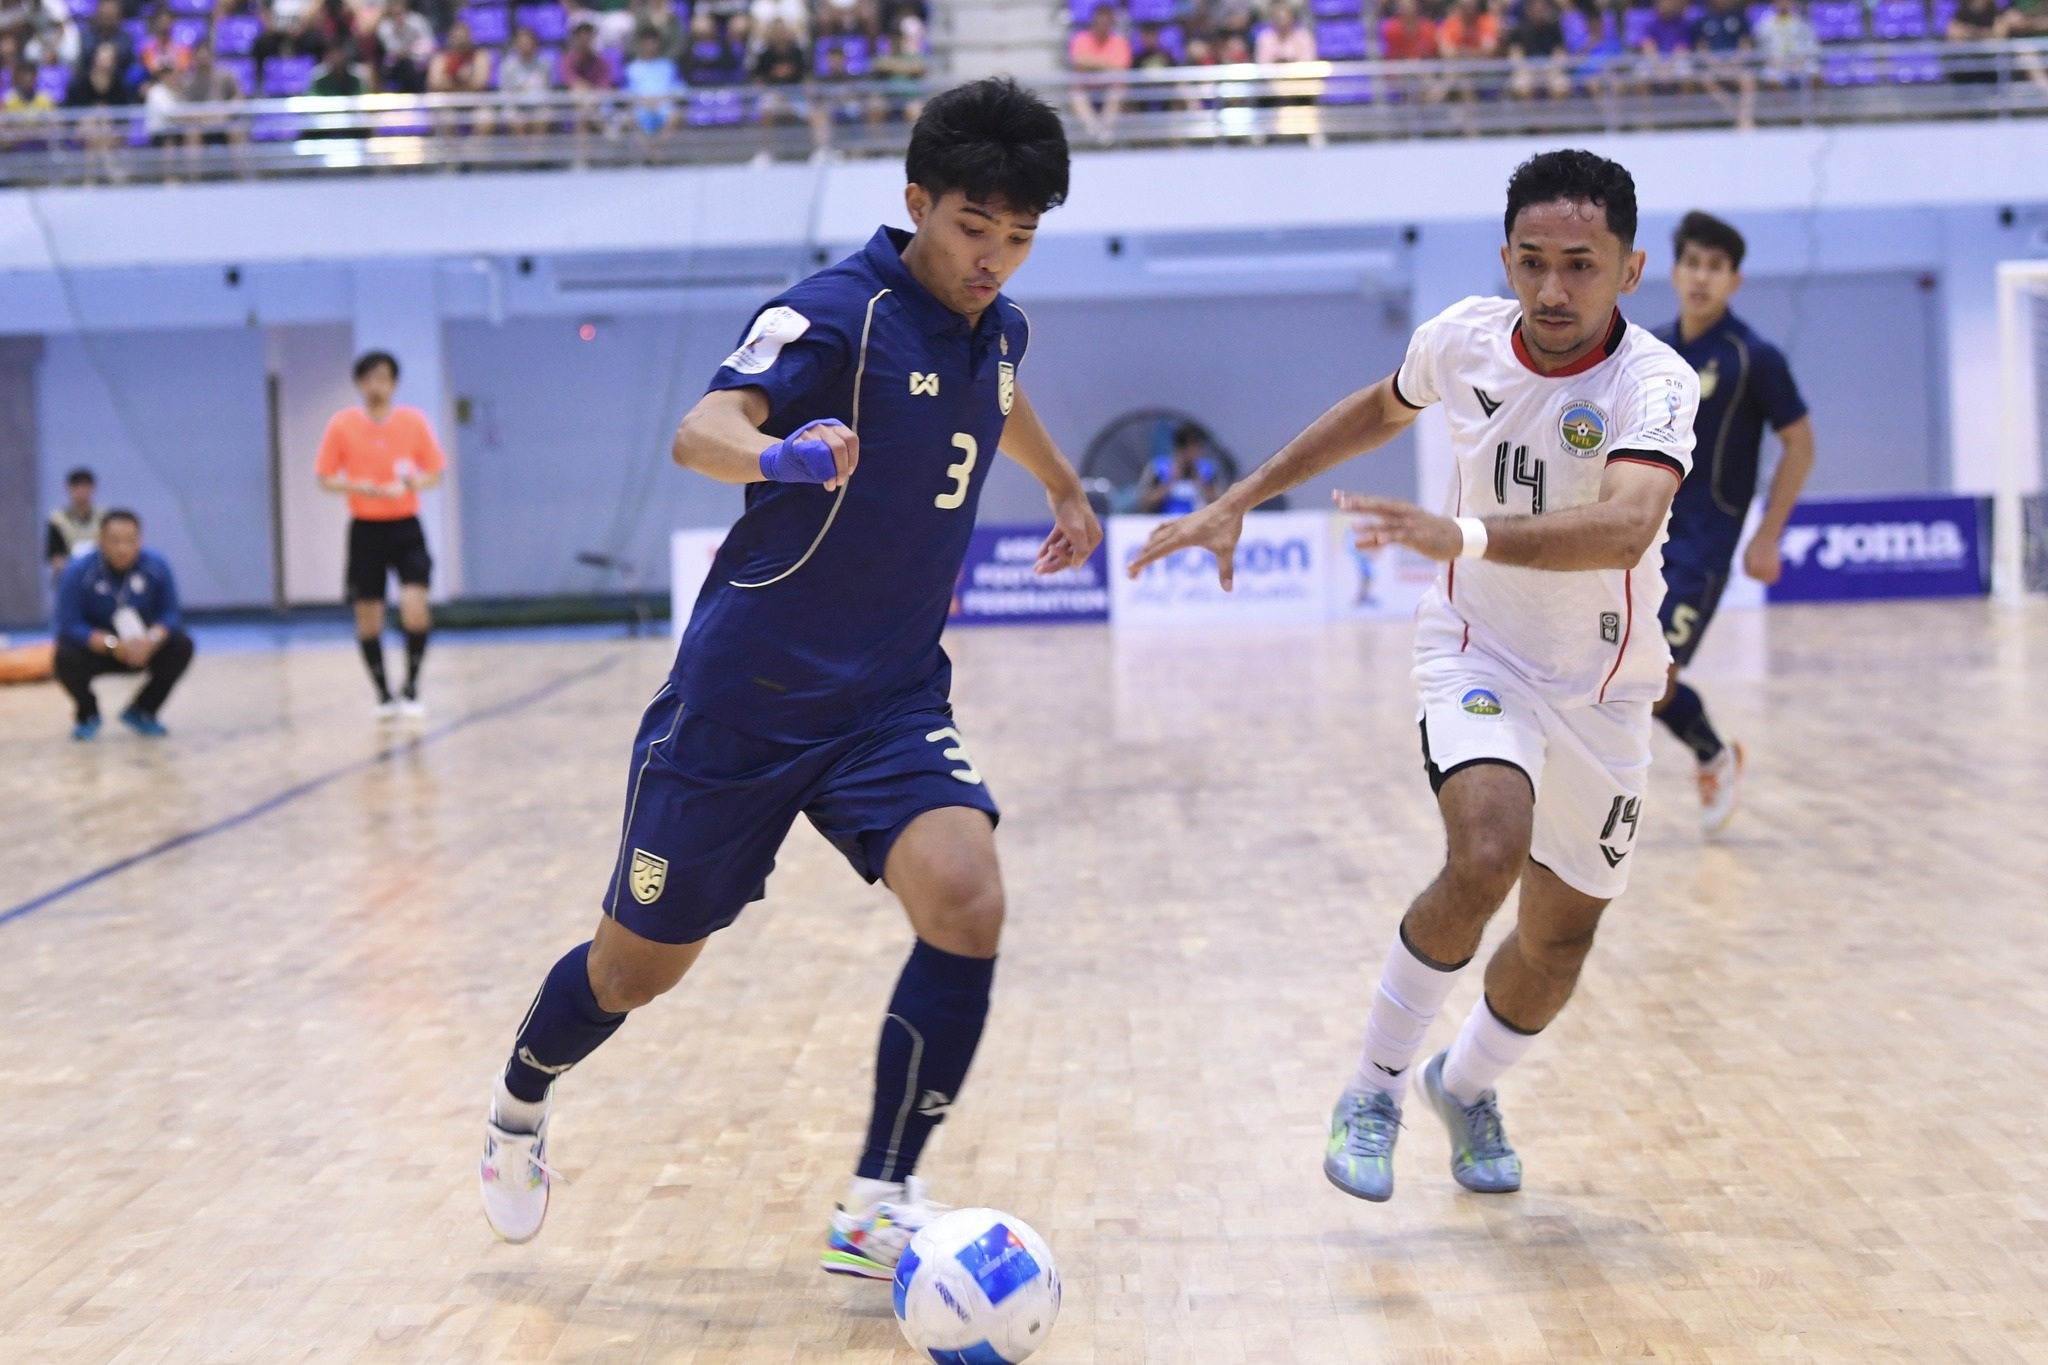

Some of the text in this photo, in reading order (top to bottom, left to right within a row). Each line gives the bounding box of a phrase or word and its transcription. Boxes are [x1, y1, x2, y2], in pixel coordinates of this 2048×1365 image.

[933, 432, 978, 510] 3
[1494, 441, 1546, 515] 14
[1124, 532, 1310, 577] moen
[1664, 602, 1699, 647] 5
[925, 726, 983, 785] 3
[1598, 795, 1643, 843] 14
